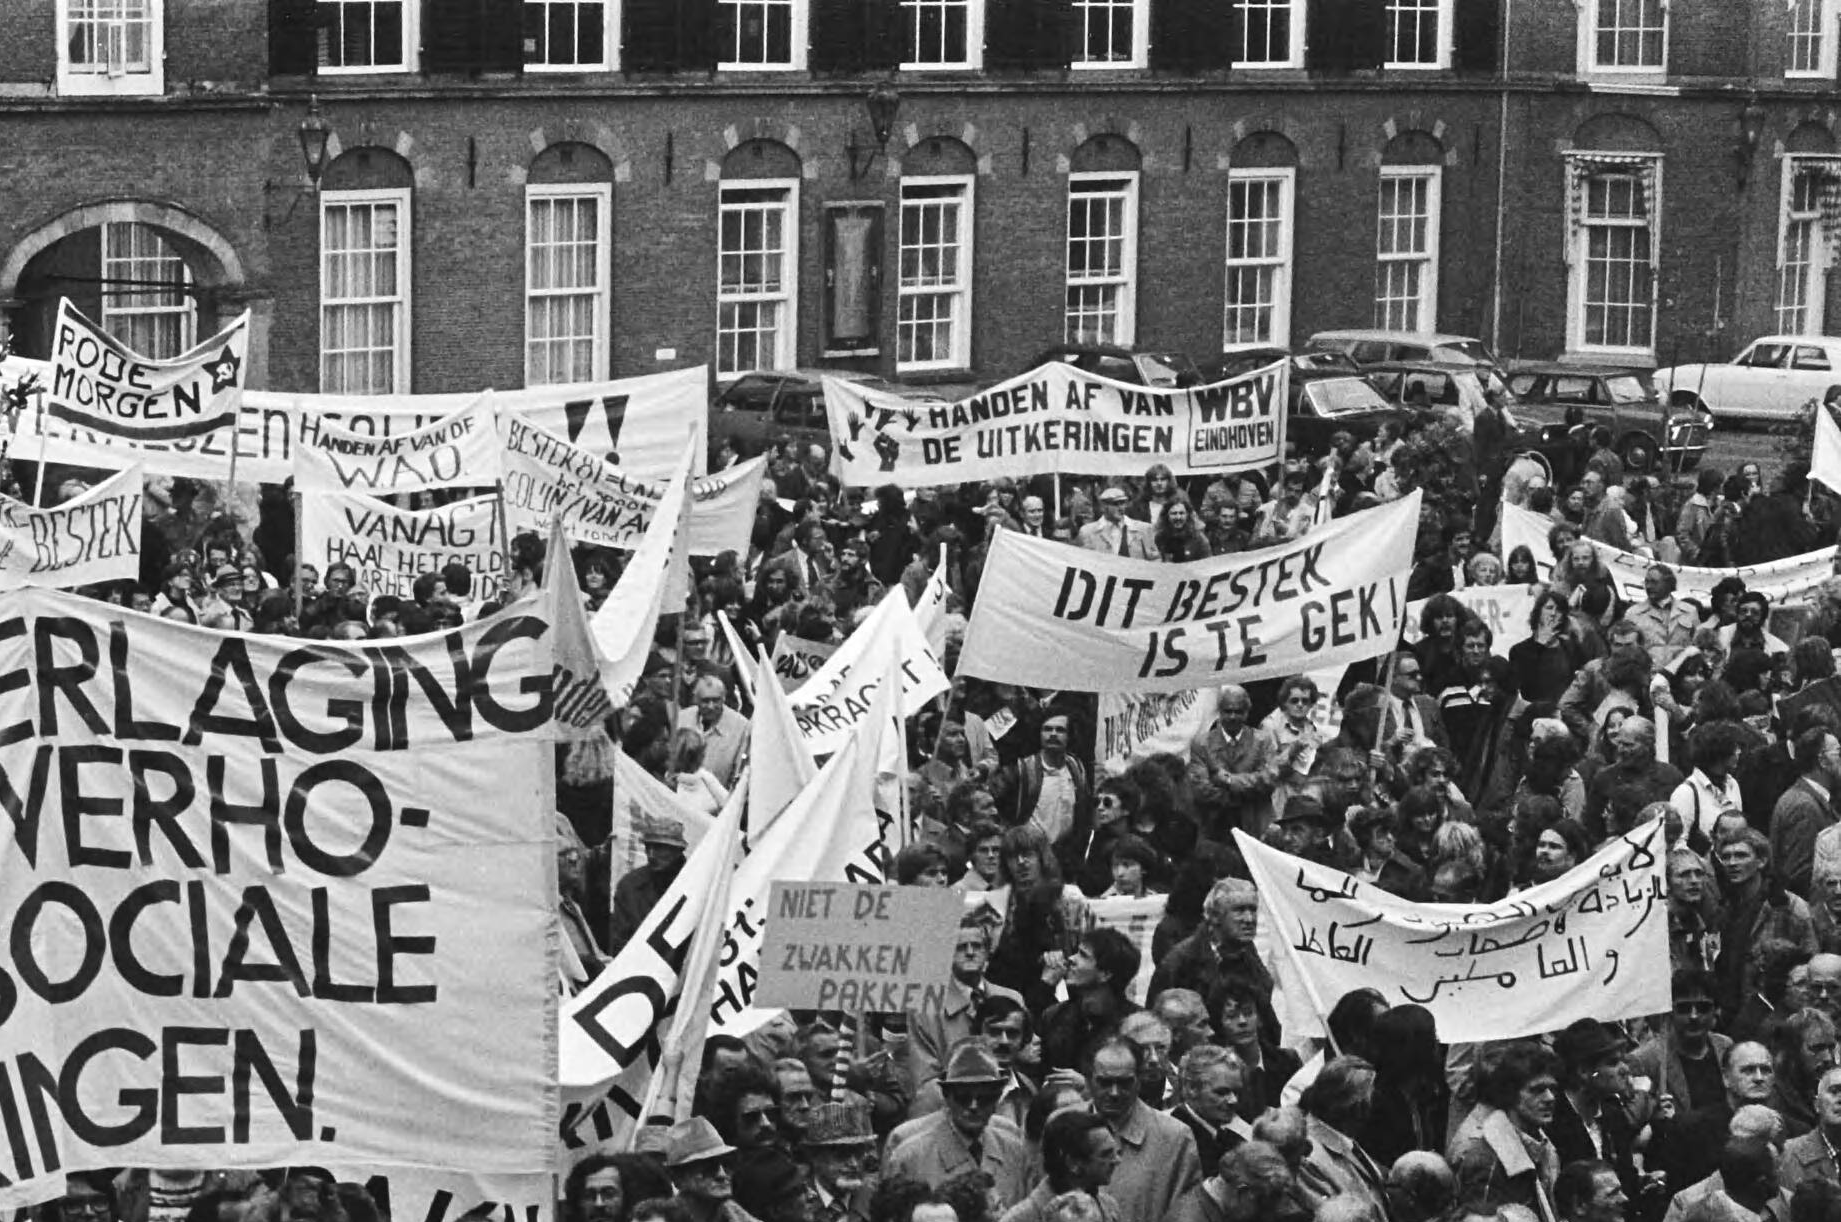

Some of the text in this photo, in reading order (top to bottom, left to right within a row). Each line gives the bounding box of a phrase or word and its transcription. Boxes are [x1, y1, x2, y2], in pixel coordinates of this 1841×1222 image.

[58, 324, 159, 391] RODE
[52, 363, 201, 421] MORGEN
[930, 380, 1175, 430] HANDEN AF VAN
[1194, 373, 1277, 424] WBV
[299, 412, 375, 456] HANDEN
[377, 437, 408, 456] AF
[409, 428, 446, 452] VAN
[922, 421, 1174, 466] DE UITKERINGEN
[1194, 420, 1275, 453] EINDHOVEN
[327, 537, 391, 571] HAAL
[398, 551, 444, 574] HET
[1053, 541, 1331, 629] DIT BESTEK
[1138, 628, 1189, 678] IS
[1205, 615, 1267, 672] TE
[1300, 577, 1401, 653] GEK!
[780, 889, 892, 920] NIET DE
[782, 944, 912, 975] ZWAKKEN
[818, 978, 946, 1013] PAKKEN
